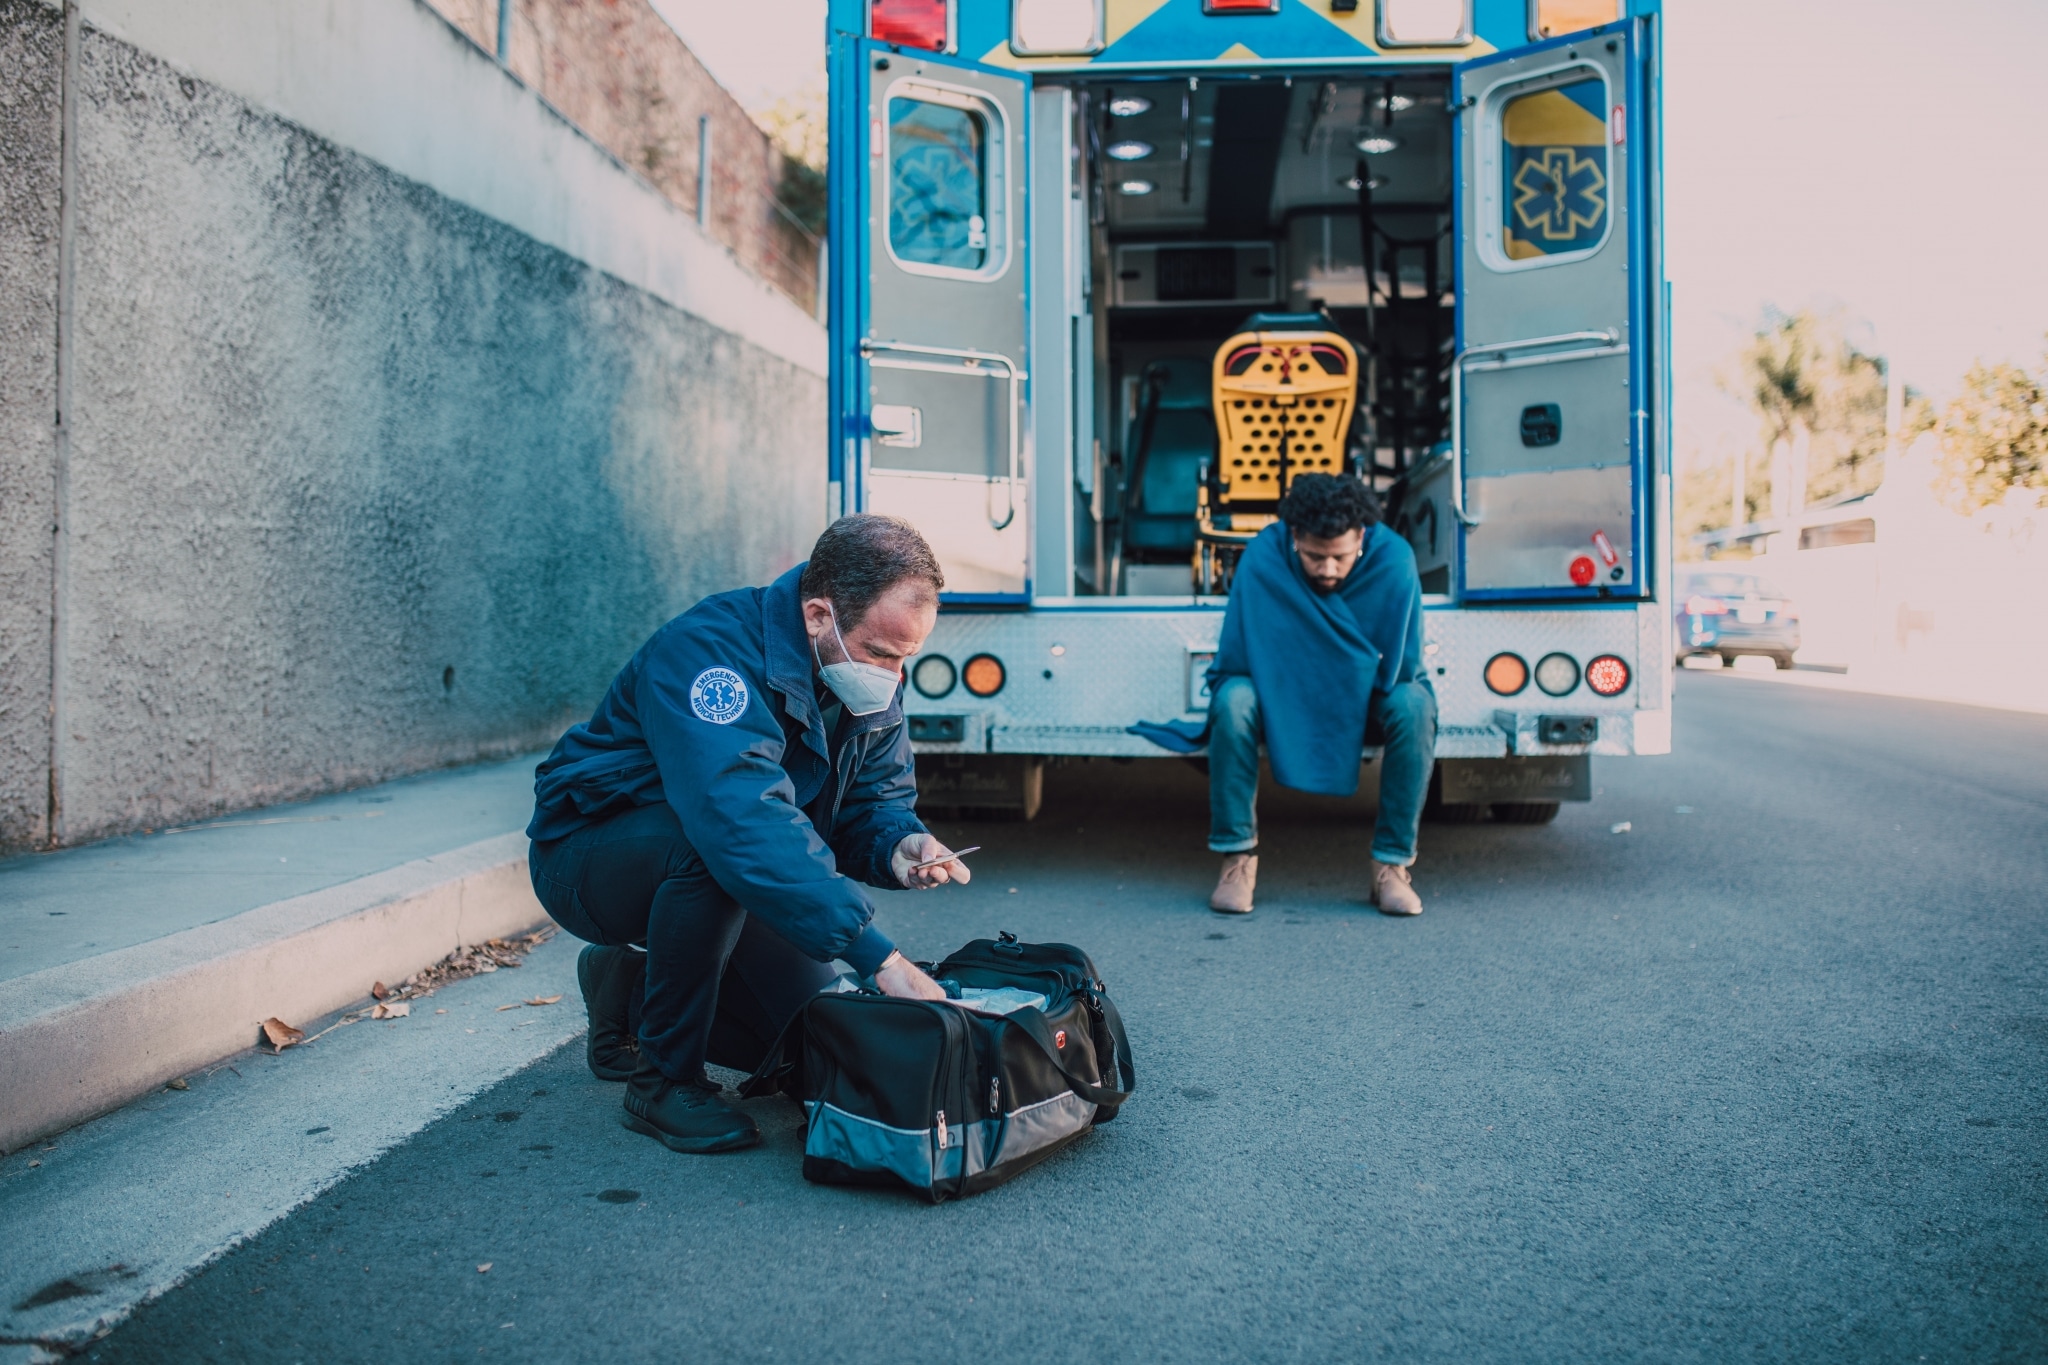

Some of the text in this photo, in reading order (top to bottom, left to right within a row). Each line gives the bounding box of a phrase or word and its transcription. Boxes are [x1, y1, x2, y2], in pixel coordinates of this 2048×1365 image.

[696, 671, 739, 689] EMERGENCY
[693, 691, 745, 721] MEDICAL TECHNICIAN
